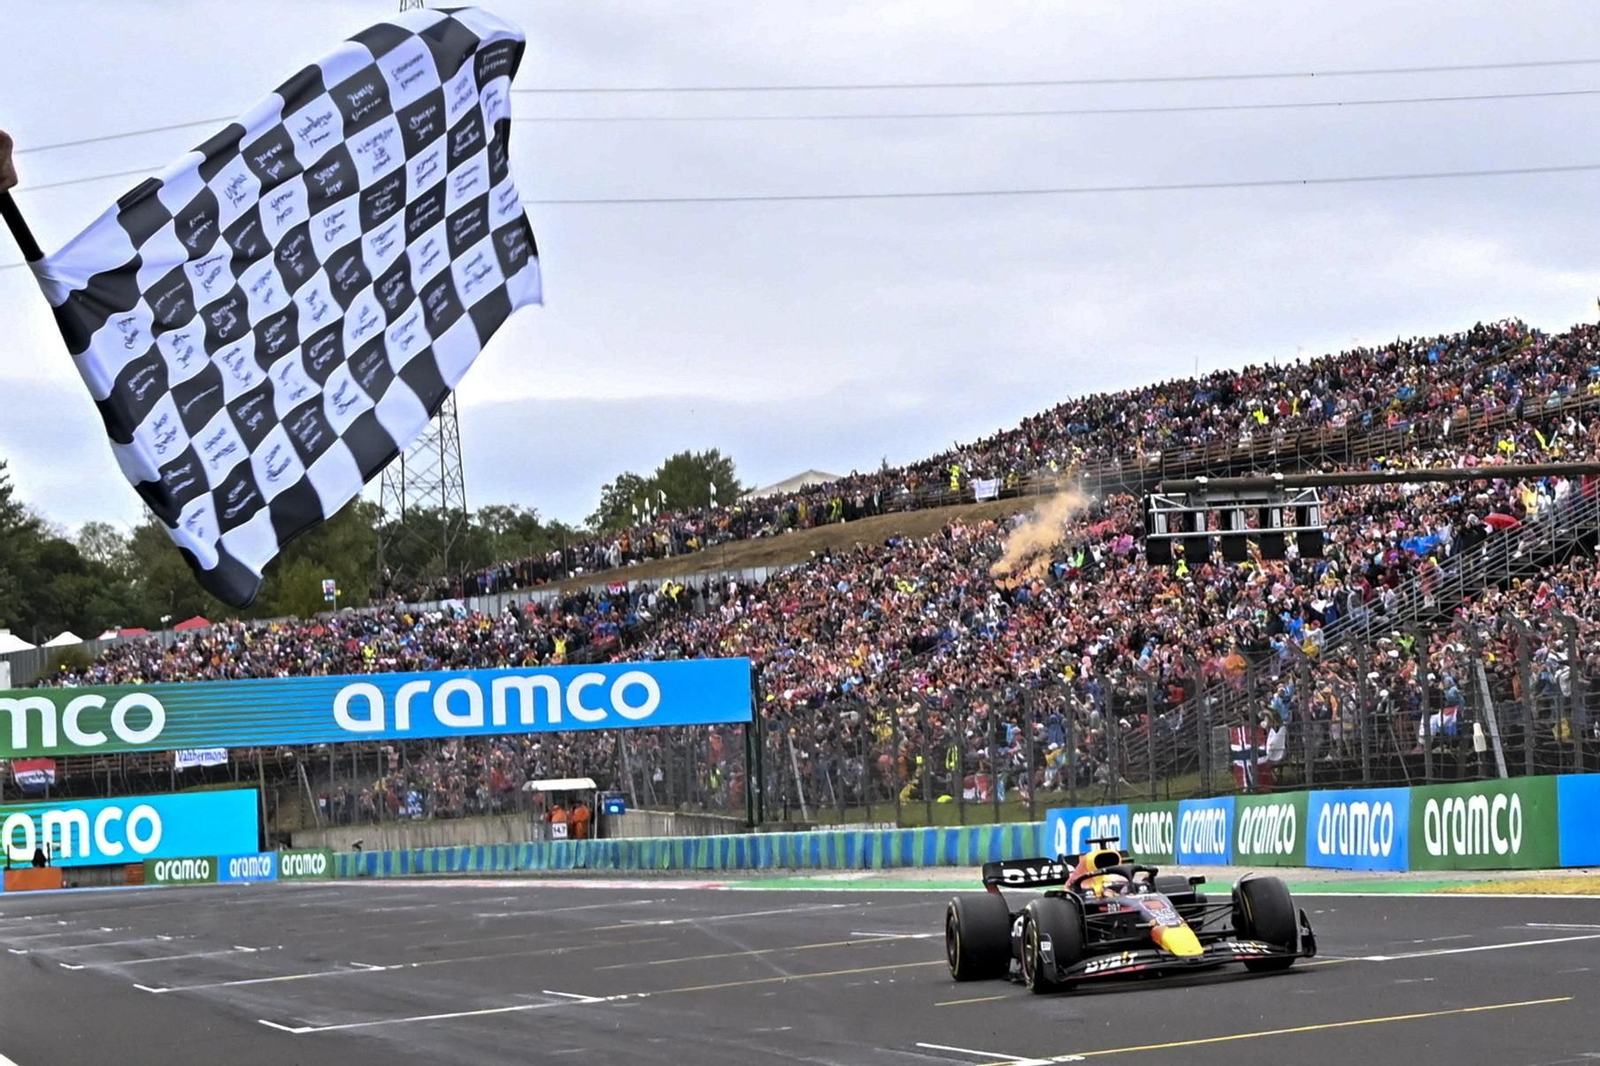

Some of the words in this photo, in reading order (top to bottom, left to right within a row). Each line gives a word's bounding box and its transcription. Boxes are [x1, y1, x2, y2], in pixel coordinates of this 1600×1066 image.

[333, 670, 661, 731] aramco
[1, 804, 162, 861] amco
[1131, 811, 1174, 855] aramco
[1180, 807, 1226, 854] aramco
[1238, 803, 1296, 855] aramco
[1317, 801, 1394, 857] aramco
[1423, 792, 1522, 856] aramco
[154, 859, 210, 881] aramco
[229, 854, 271, 877] aramco
[282, 853, 326, 876] aramco
